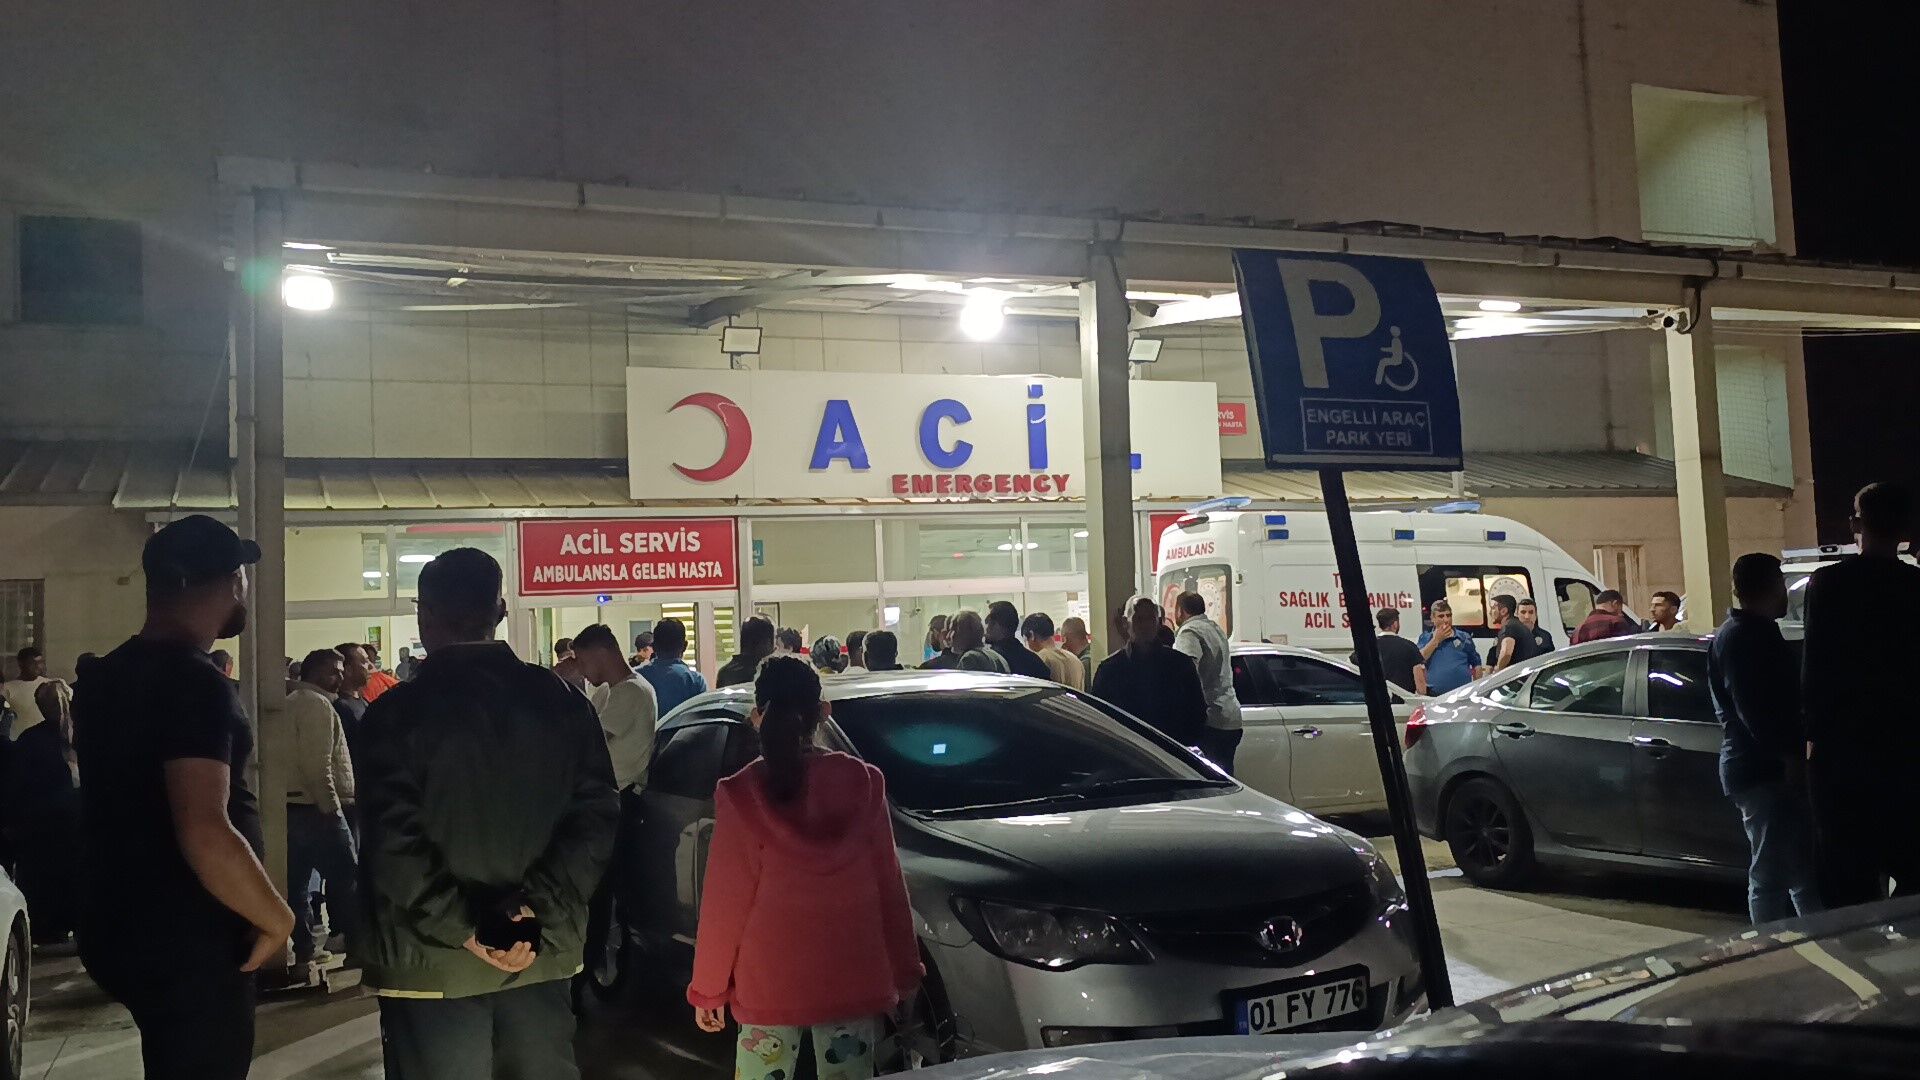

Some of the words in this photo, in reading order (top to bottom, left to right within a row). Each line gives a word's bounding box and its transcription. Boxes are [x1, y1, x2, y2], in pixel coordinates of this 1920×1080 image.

[1277, 258, 1382, 389] P
[808, 384, 1142, 471] ACİ
[1306, 406, 1377, 425] ENGELLİ
[1381, 410, 1426, 429] ARAÇ
[1326, 429, 1370, 446] PARK
[1375, 430, 1412, 447] YERİ
[891, 473, 1070, 495] EMERGENCY
[560, 528, 614, 555] ACİL
[619, 526, 701, 553] SERVİS
[1166, 541, 1215, 561] AMBULANS
[532, 563, 629, 583] AMBULANSLA
[632, 561, 676, 580] GELEN
[679, 560, 723, 578] HASTA
[1279, 588, 1330, 608] SAĞLIK
[1304, 609, 1335, 629] ACİL
[1250, 998, 1277, 1031] 01
[1286, 989, 1316, 1023] FY
[1323, 980, 1364, 1015] 776
